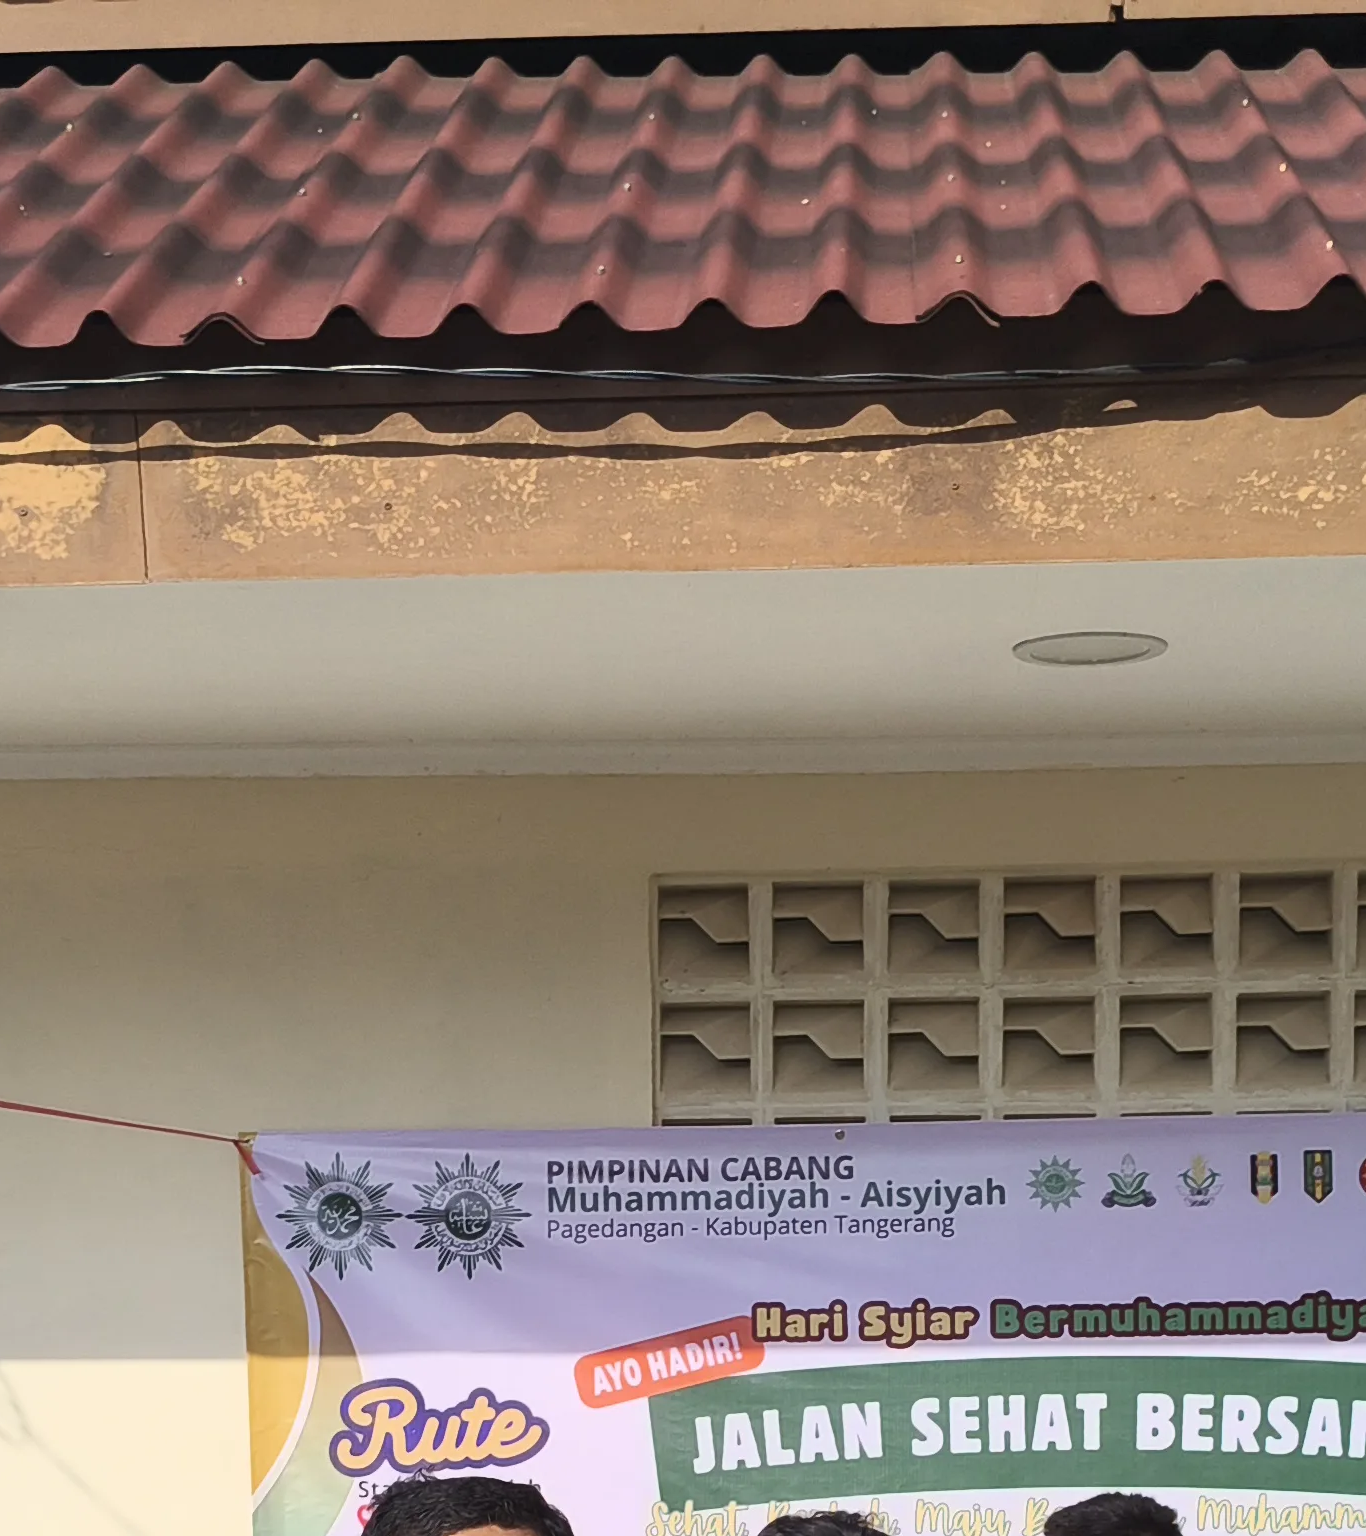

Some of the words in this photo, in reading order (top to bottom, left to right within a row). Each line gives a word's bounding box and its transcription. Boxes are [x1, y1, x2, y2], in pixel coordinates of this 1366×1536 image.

[547, 1159, 710, 1184] PIMPINAN
[720, 1155, 854, 1181] CABANG
[548, 1182, 830, 1217] Muhammadiyah
[860, 1177, 1006, 1214] Aisyiyah
[547, 1218, 684, 1243] Pagedangan
[706, 1215, 827, 1240] Kabupaten
[835, 1214, 956, 1237] Tangerang
[753, 1301, 846, 1340] Hari
[861, 1300, 977, 1346] Syiar
[592, 1357, 643, 1397] AYO
[647, 1332, 745, 1381] HADIR!
[332, 1380, 547, 1474] Rute
[692, 1402, 883, 1474] JALAN
[910, 1392, 1108, 1457] SEHAT
